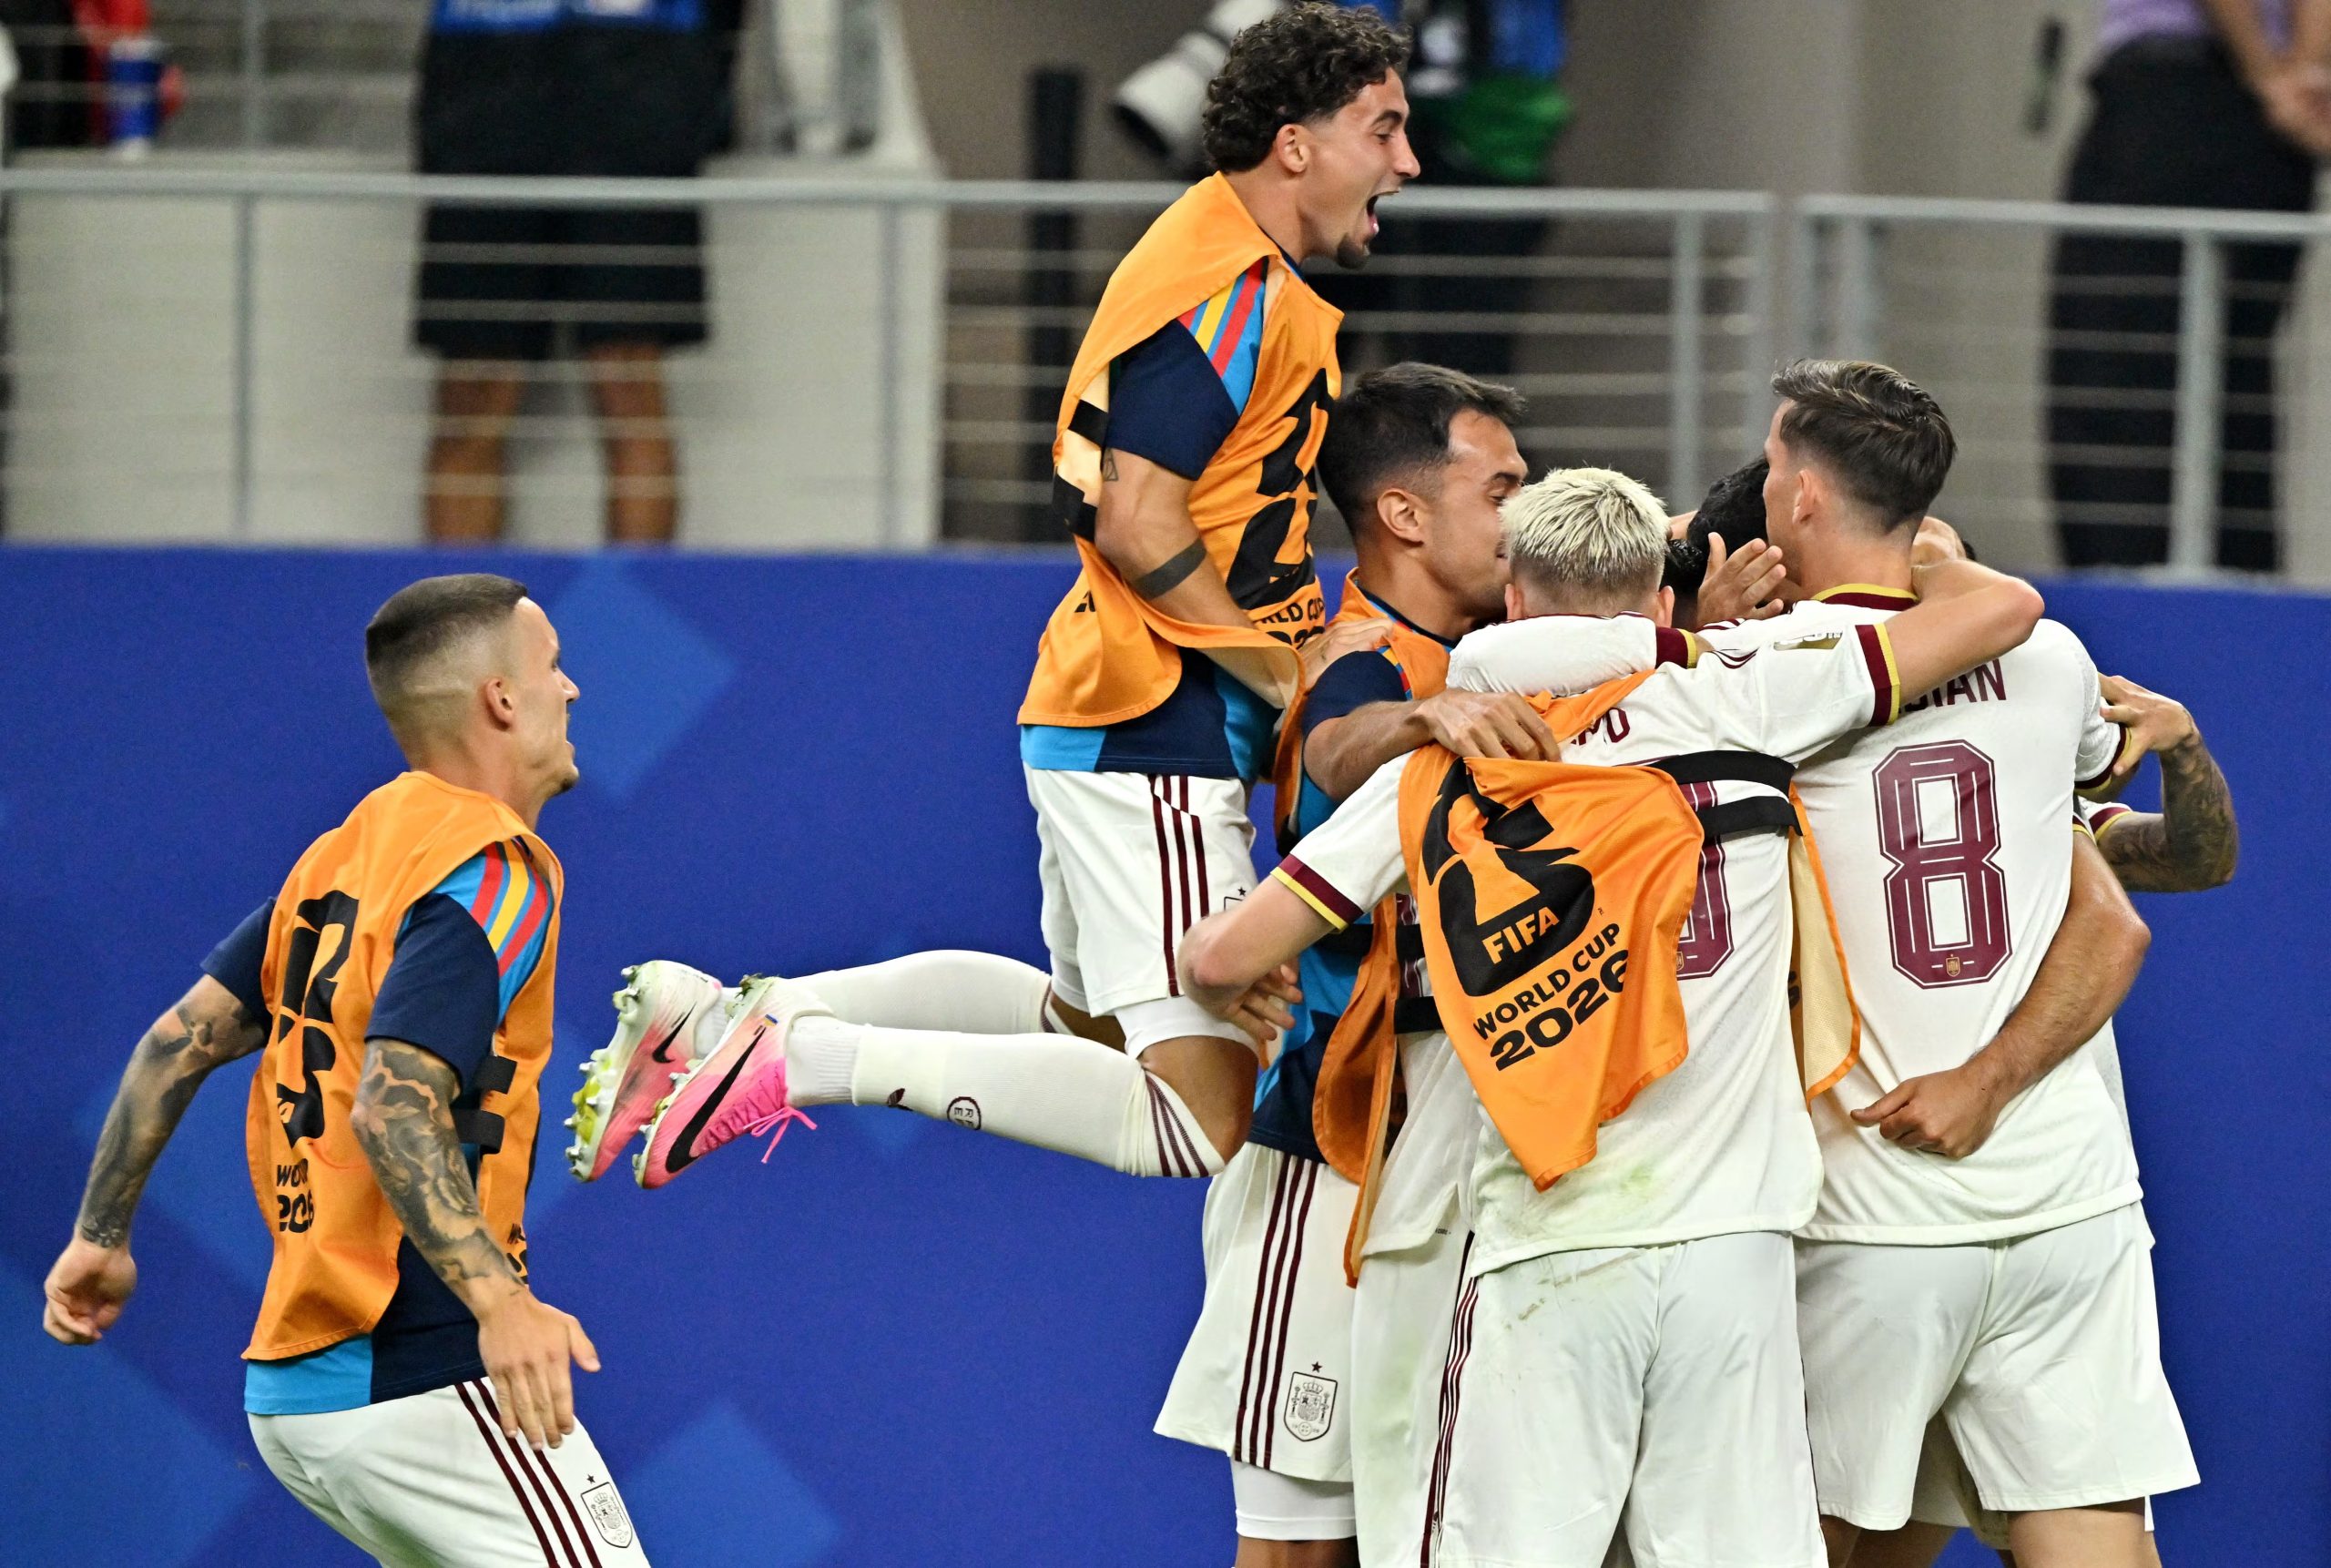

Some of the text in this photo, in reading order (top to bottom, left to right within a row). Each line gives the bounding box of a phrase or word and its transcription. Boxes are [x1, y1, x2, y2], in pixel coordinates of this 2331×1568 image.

[1872, 739, 2012, 989] 8
[1473, 922, 1620, 1041] WORLD CUP
[1481, 906, 1560, 964] FIFA
[1490, 949, 1629, 1072] 2026
